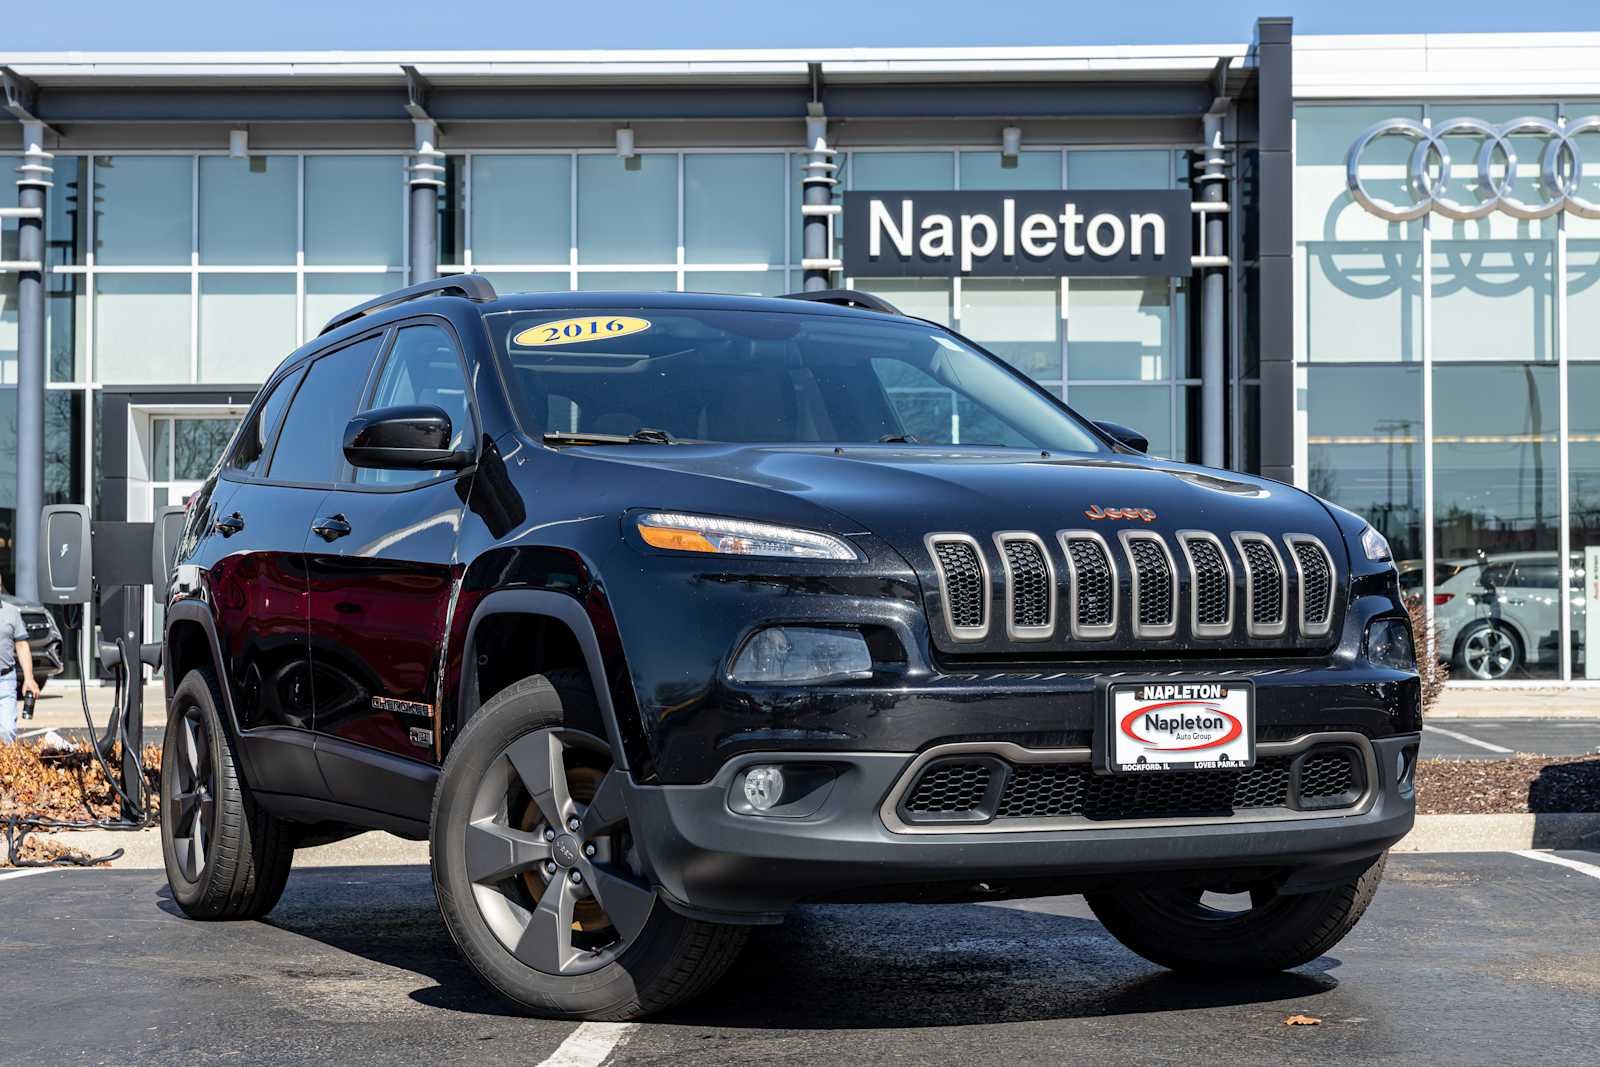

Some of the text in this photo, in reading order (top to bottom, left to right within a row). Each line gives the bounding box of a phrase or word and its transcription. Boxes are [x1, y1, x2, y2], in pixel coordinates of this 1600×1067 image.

[869, 199, 1166, 272] Napleton
[542, 319, 624, 342] 2016
[1083, 504, 1157, 523] Jeep
[1143, 684, 1222, 700] NAPLETON
[1145, 713, 1224, 734] Napleton
[1176, 732, 1212, 741] Auto Group
[1194, 761, 1217, 769] LOVES
